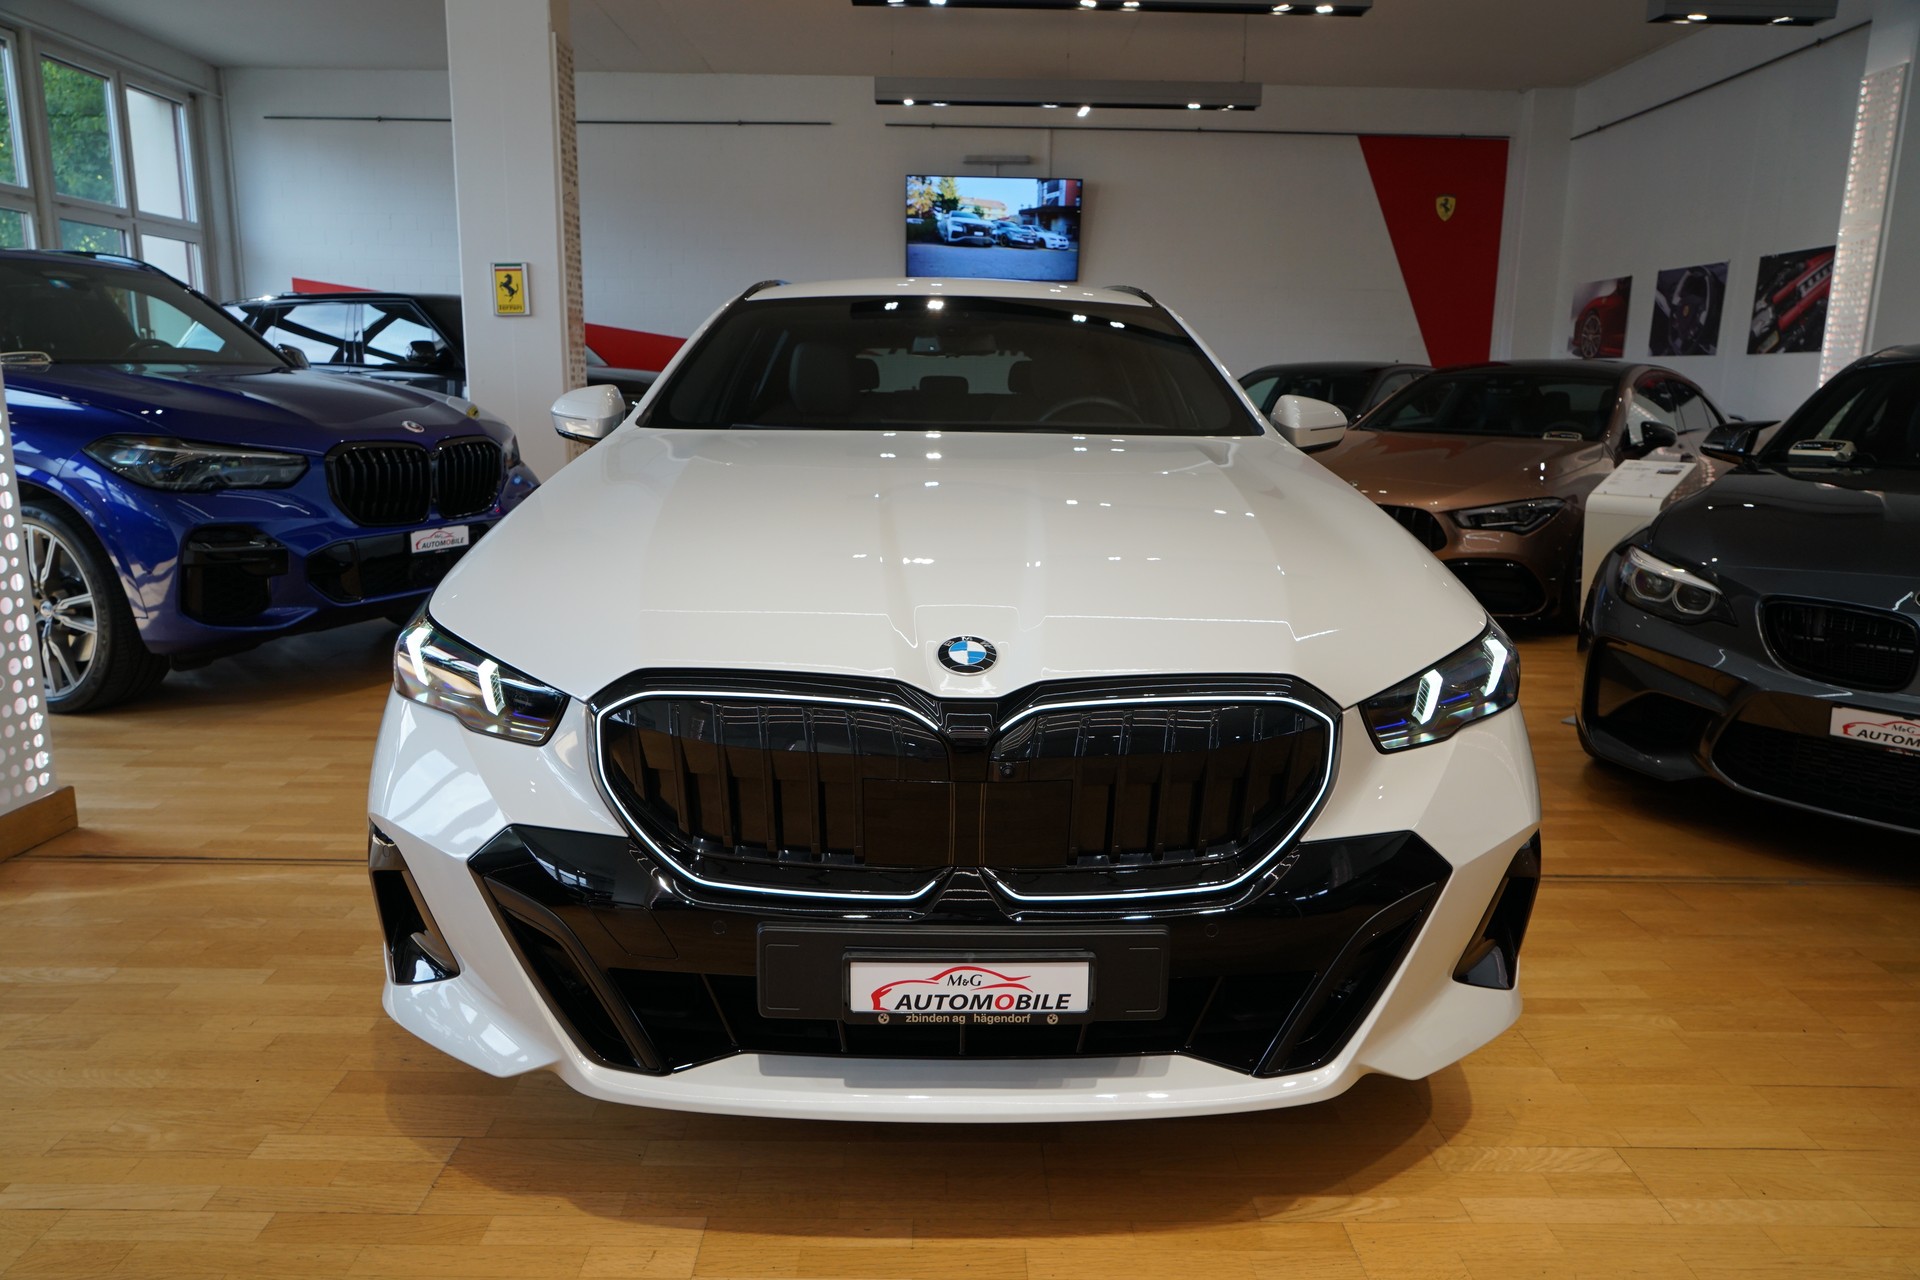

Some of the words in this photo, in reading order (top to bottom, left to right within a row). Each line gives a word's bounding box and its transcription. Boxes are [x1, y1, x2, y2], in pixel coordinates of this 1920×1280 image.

[421, 537, 465, 549] AUTOMOBILE
[946, 974, 983, 987] M&G
[894, 993, 1072, 1011] AUTOMOBILE
[905, 1013, 950, 1024] zbinden
[952, 1015, 966, 1025] ag
[973, 1013, 1031, 1025] hägendorf
